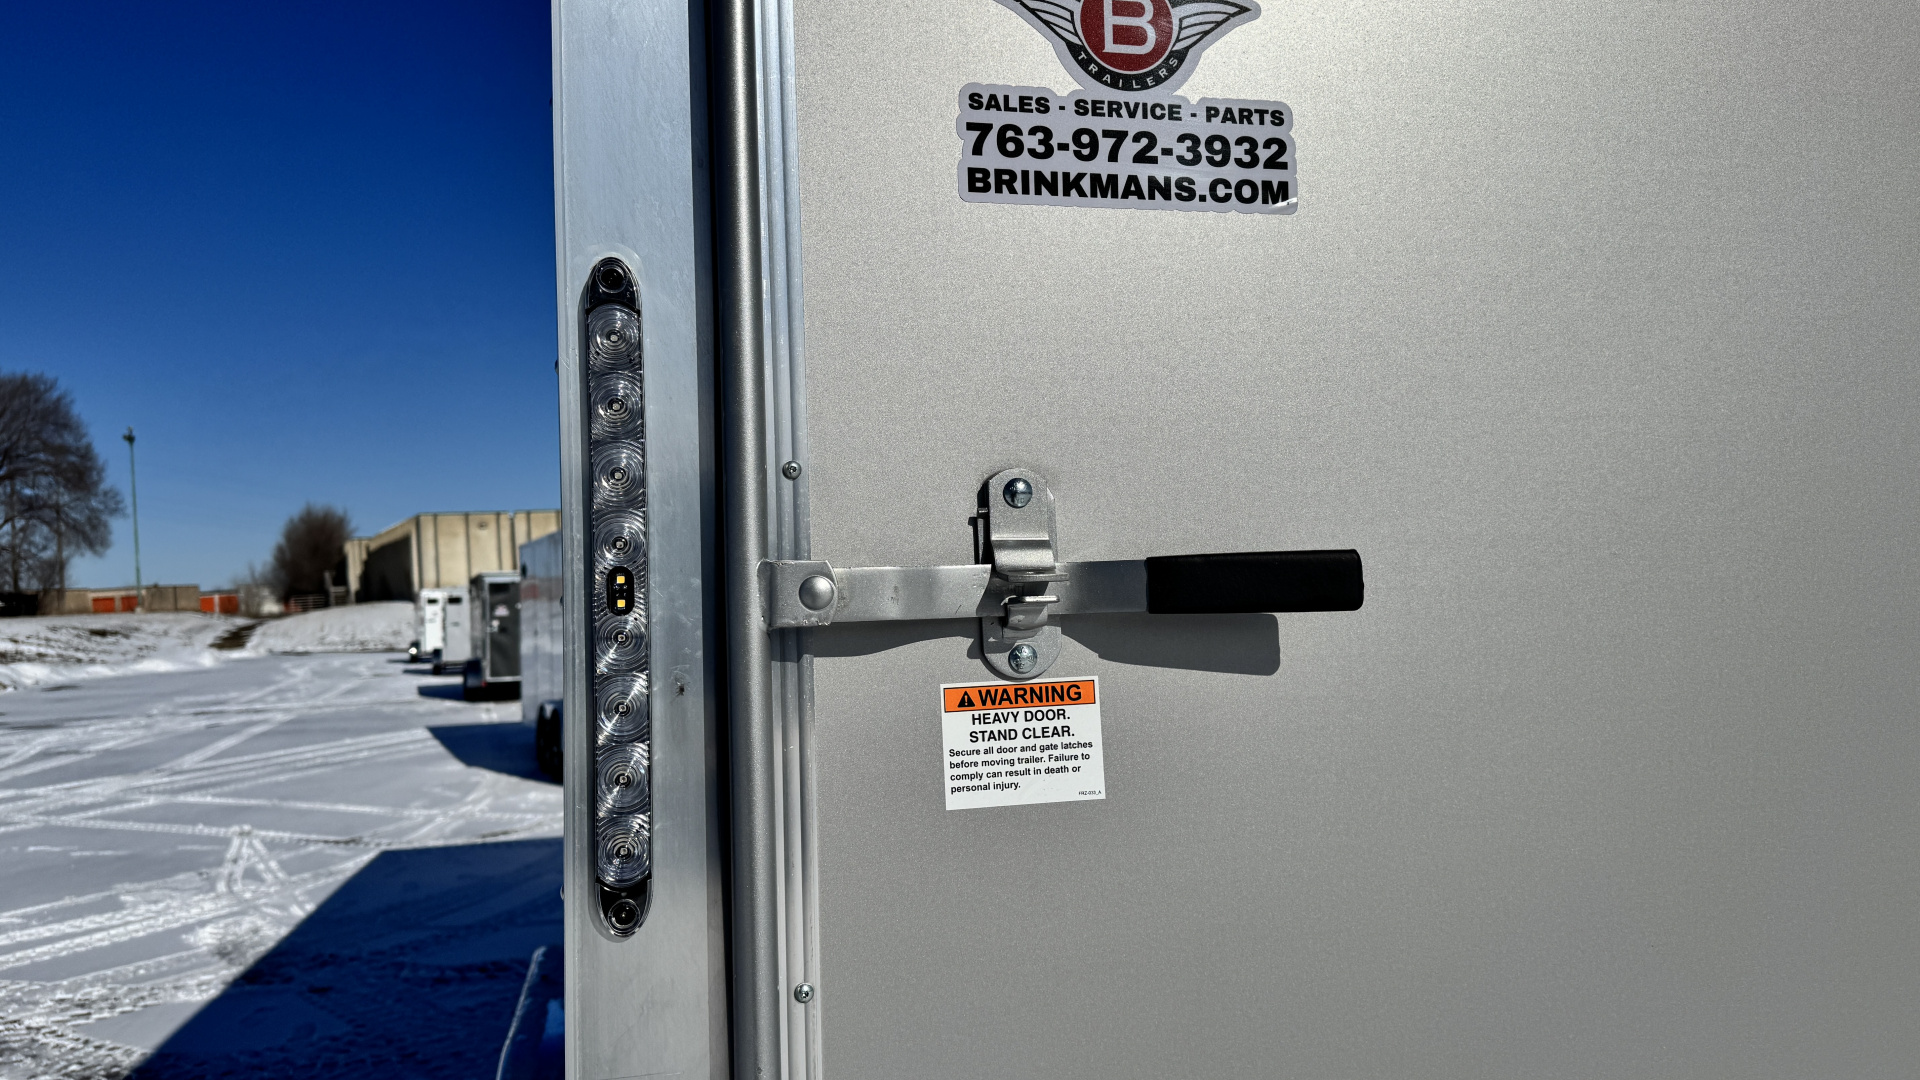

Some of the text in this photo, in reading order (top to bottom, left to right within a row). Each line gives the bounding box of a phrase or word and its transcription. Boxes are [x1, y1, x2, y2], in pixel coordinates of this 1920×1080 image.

[1102, 0, 1156, 55] B
[1078, 52, 1178, 89] TRAILERS
[968, 93, 1050, 114] SALES
[1074, 99, 1182, 121] SERVICE
[1205, 107, 1285, 126] PARTS
[966, 122, 1288, 170] 763-972-3932
[967, 167, 1289, 205] BRINKMANS.COM
[978, 684, 1081, 706] WARNING
[972, 709, 1070, 725] HEAVY DOOR.
[970, 726, 1074, 743] STAND CLEAR.
[949, 749, 980, 757] Secure
[996, 746, 1017, 754] door
[1020, 744, 1036, 752] and
[1039, 743, 1058, 753] gate
[1061, 741, 1093, 749] latches
[950, 761, 979, 769] before
[982, 758, 1015, 767] moving
[1017, 756, 1045, 764] trailer.
[1048, 754, 1079, 762] Failure
[950, 772, 983, 781] comply
[1005, 769, 1030, 777] result
[1044, 766, 1069, 774] death
[951, 781, 1021, 794] personal injury.
